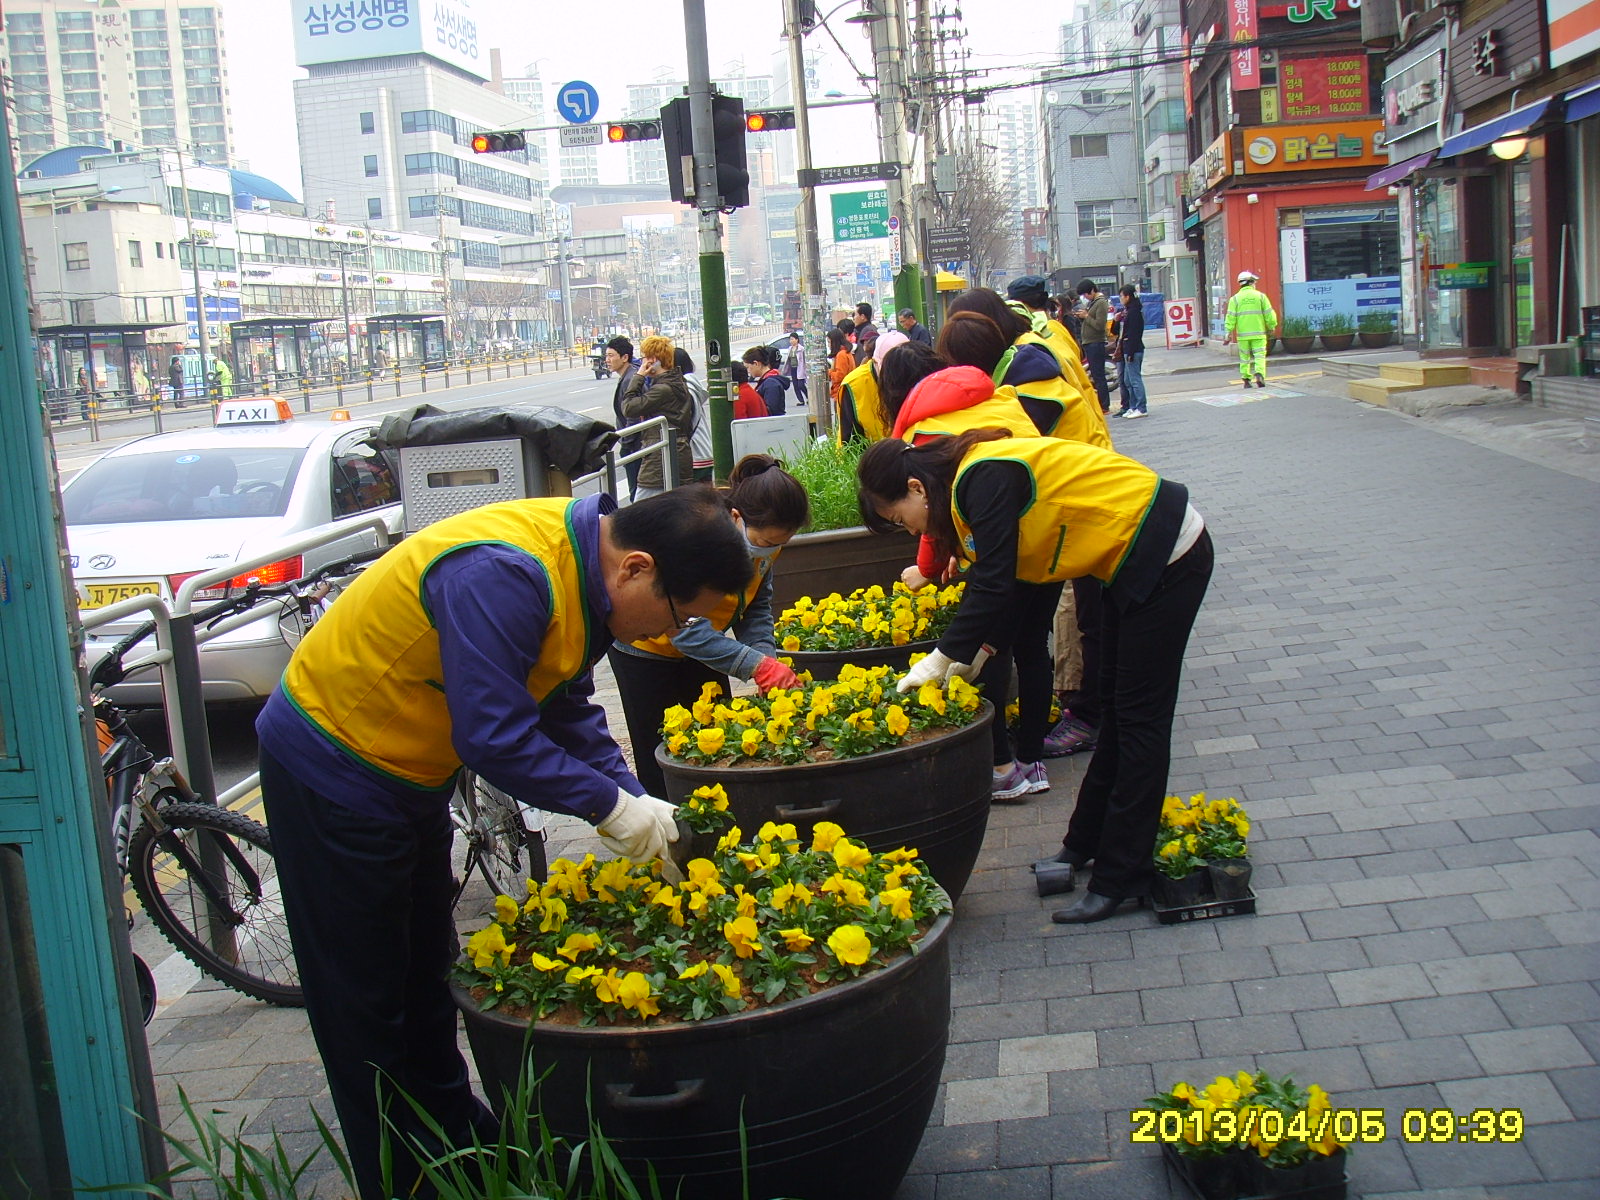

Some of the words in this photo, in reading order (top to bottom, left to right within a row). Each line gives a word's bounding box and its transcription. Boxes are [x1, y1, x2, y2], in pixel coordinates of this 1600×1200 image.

[304, 0, 410, 37] 삼성생명
[434, 3, 478, 60] 삼성생명
[1289, 231, 1298, 281] ACUVUE
[1307, 286, 1332, 296] 아큐브
[1169, 303, 1194, 332] 약
[1308, 302, 1334, 312] 아큐브
[225, 407, 268, 421] TAXI
